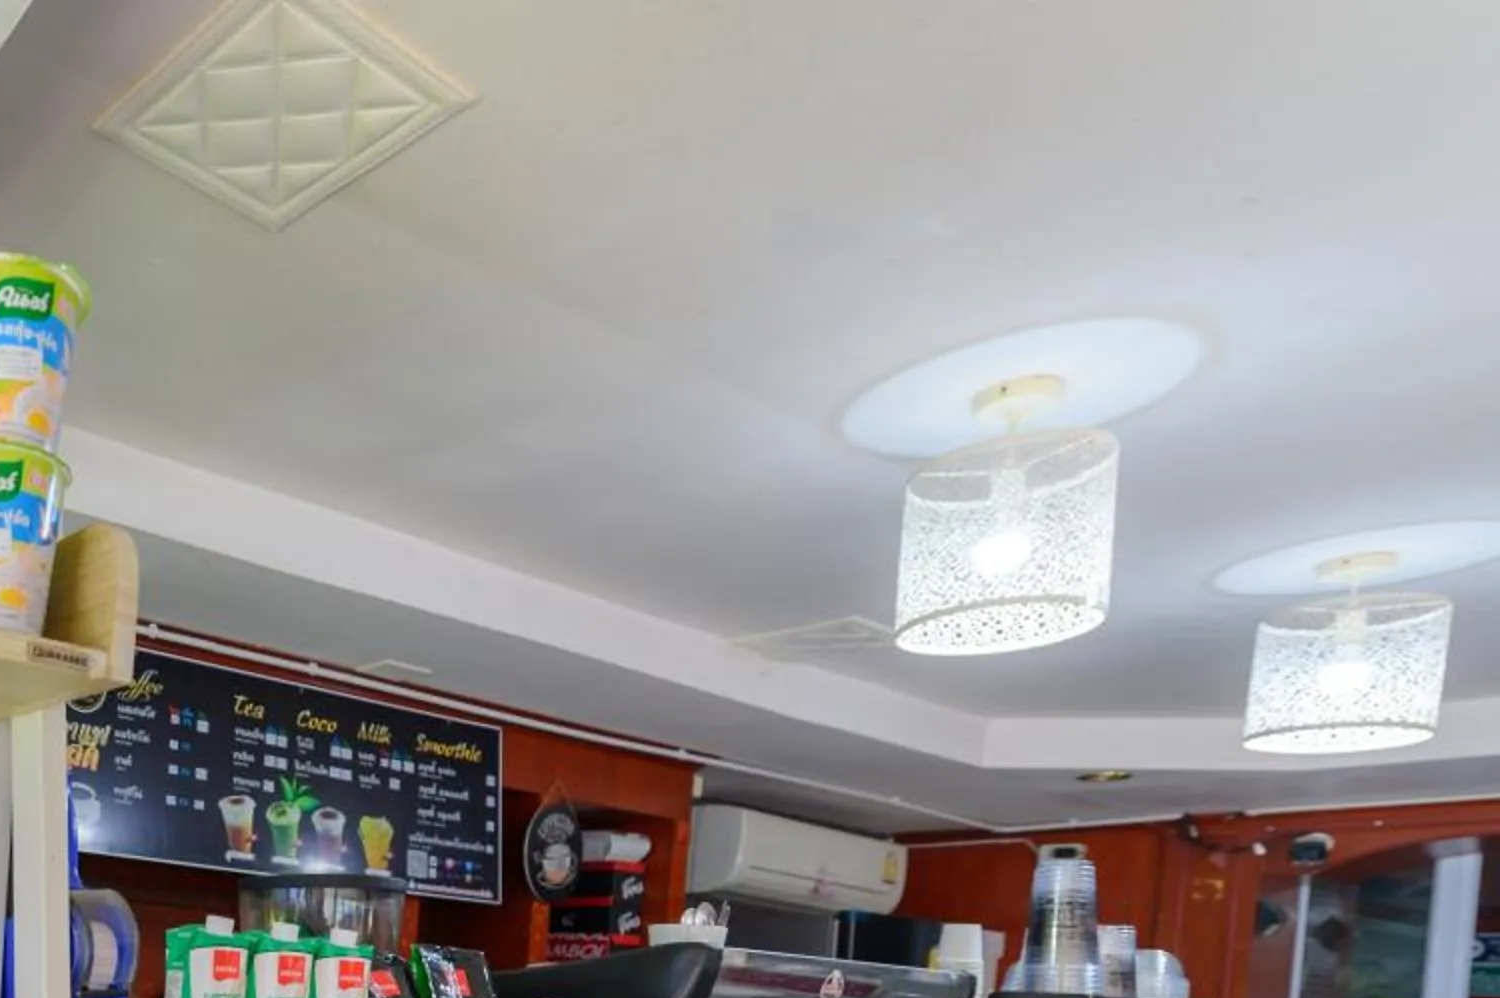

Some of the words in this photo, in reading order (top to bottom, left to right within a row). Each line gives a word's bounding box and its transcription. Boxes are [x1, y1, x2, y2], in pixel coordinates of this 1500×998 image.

[233, 694, 266, 719] Tea
[296, 709, 338, 733] Coco
[357, 721, 393, 745] Milk
[417, 733, 483, 763] Smoothie
